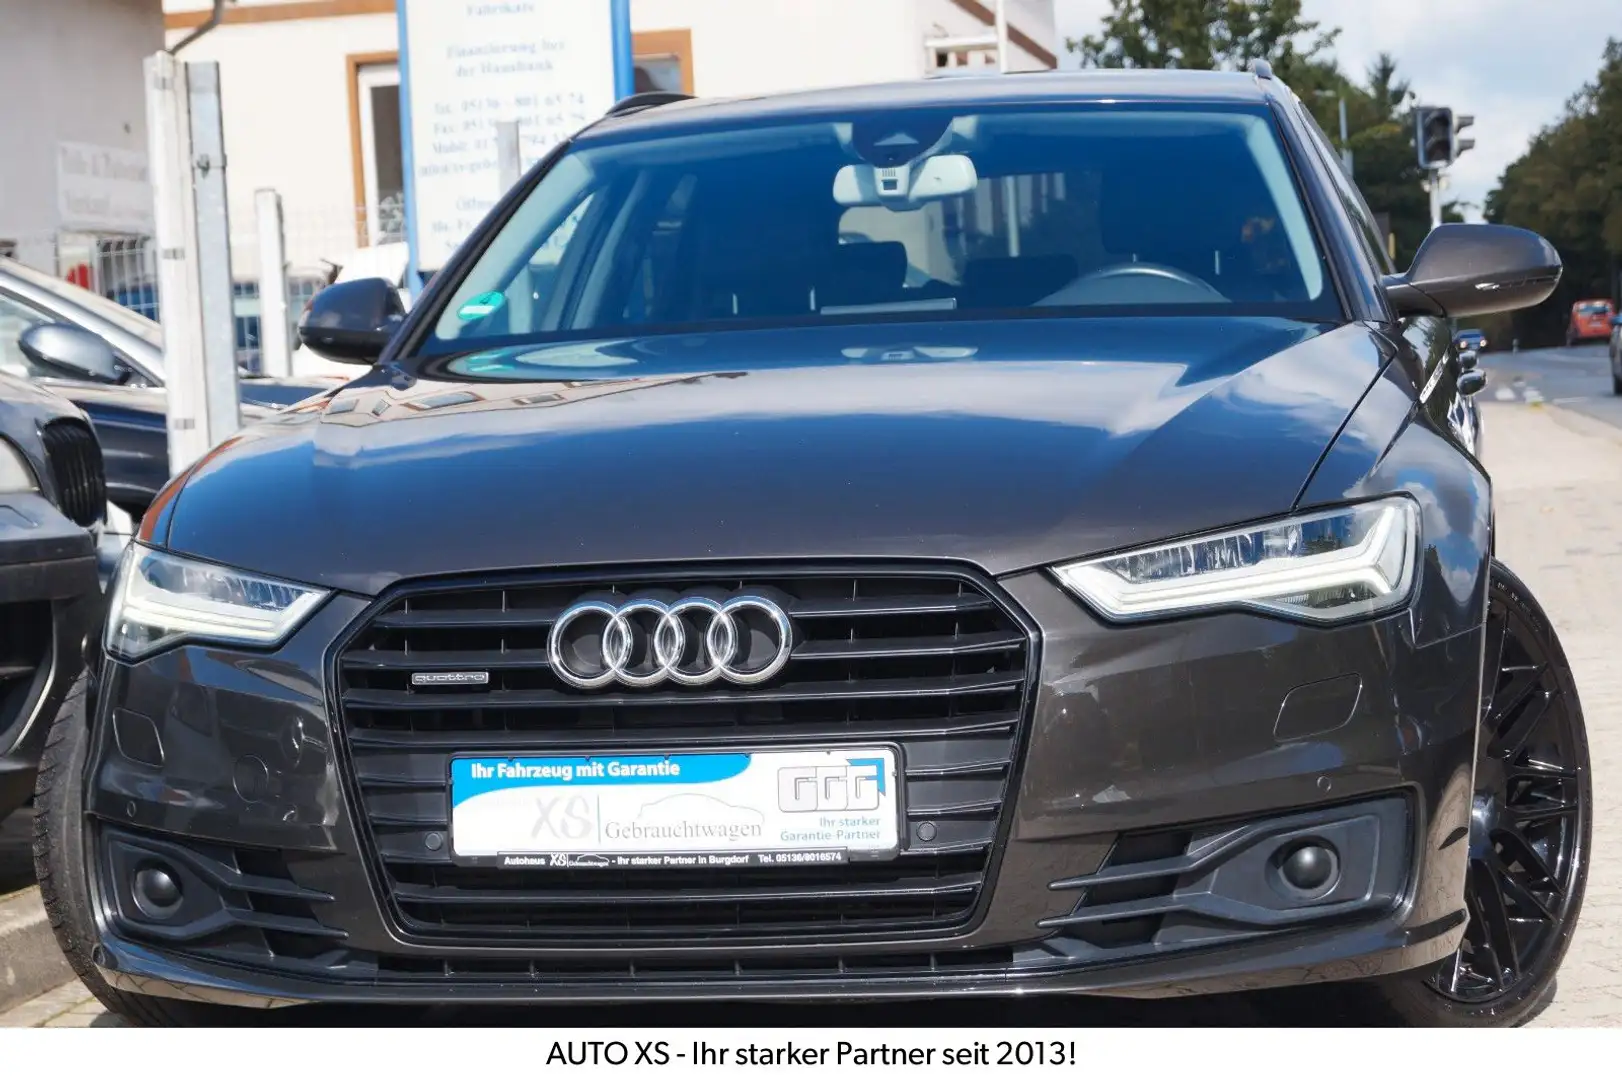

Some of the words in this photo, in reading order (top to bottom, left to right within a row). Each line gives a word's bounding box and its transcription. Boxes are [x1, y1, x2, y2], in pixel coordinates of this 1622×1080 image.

[471, 763, 494, 778] Ihr
[497, 763, 572, 781] Fahrzeug
[576, 761, 604, 777] mit
[607, 760, 681, 777] Garantie
[530, 794, 593, 839] XS
[820, 816, 836, 828] Ihr
[839, 816, 880, 827] starker
[605, 820, 762, 842] Gebrauchtwagen
[504, 856, 546, 866] Autohaus
[550, 852, 566, 867] XS
[617, 856, 629, 865] Ihr
[631, 855, 663, 865] starker
[664, 855, 696, 865] Partner
[698, 854, 707, 864] in
[708, 854, 749, 866] Burgdorf
[758, 853, 774, 863] Tel.
